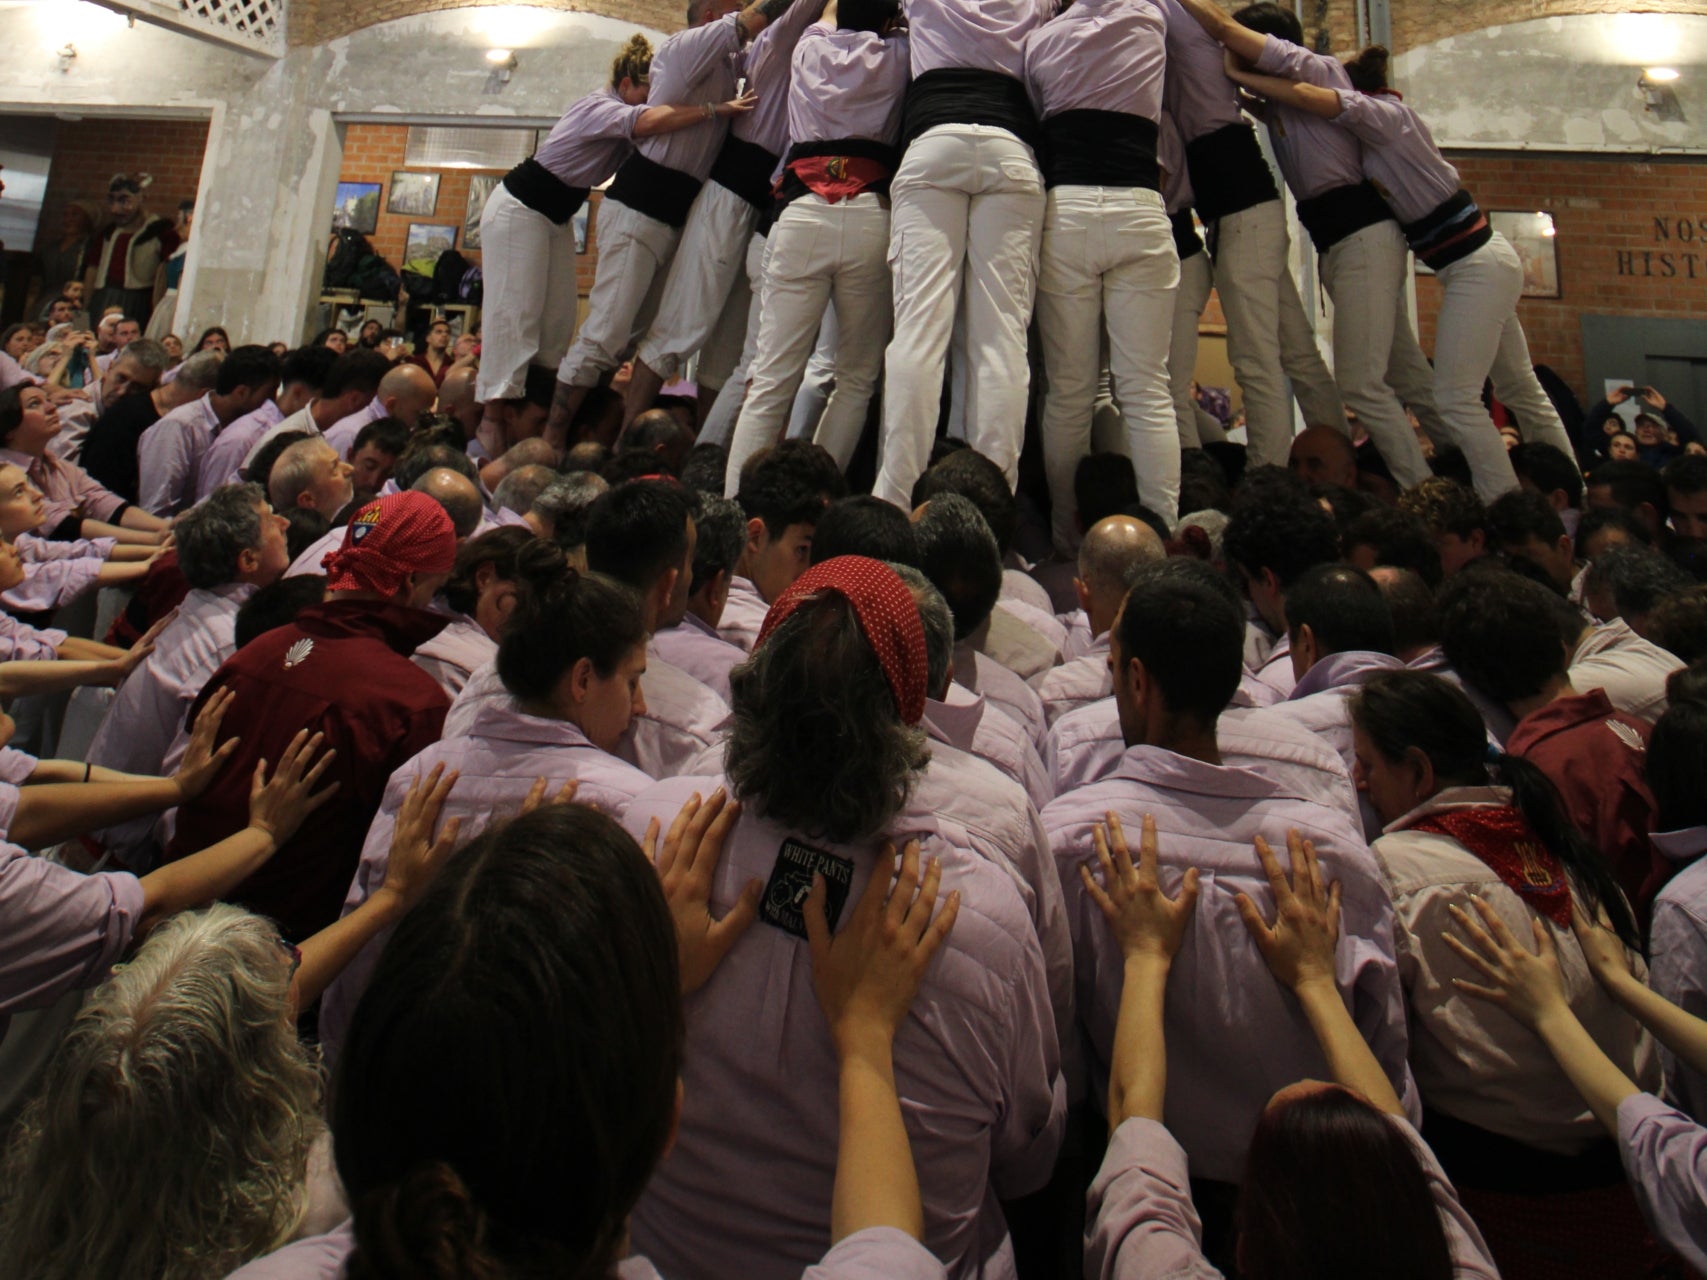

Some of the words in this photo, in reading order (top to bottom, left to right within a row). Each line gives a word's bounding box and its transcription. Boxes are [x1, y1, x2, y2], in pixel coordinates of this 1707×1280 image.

[1616, 250, 1707, 279] HIST
[784, 843, 815, 867] WHITE
[816, 855, 850, 884] PANTS
